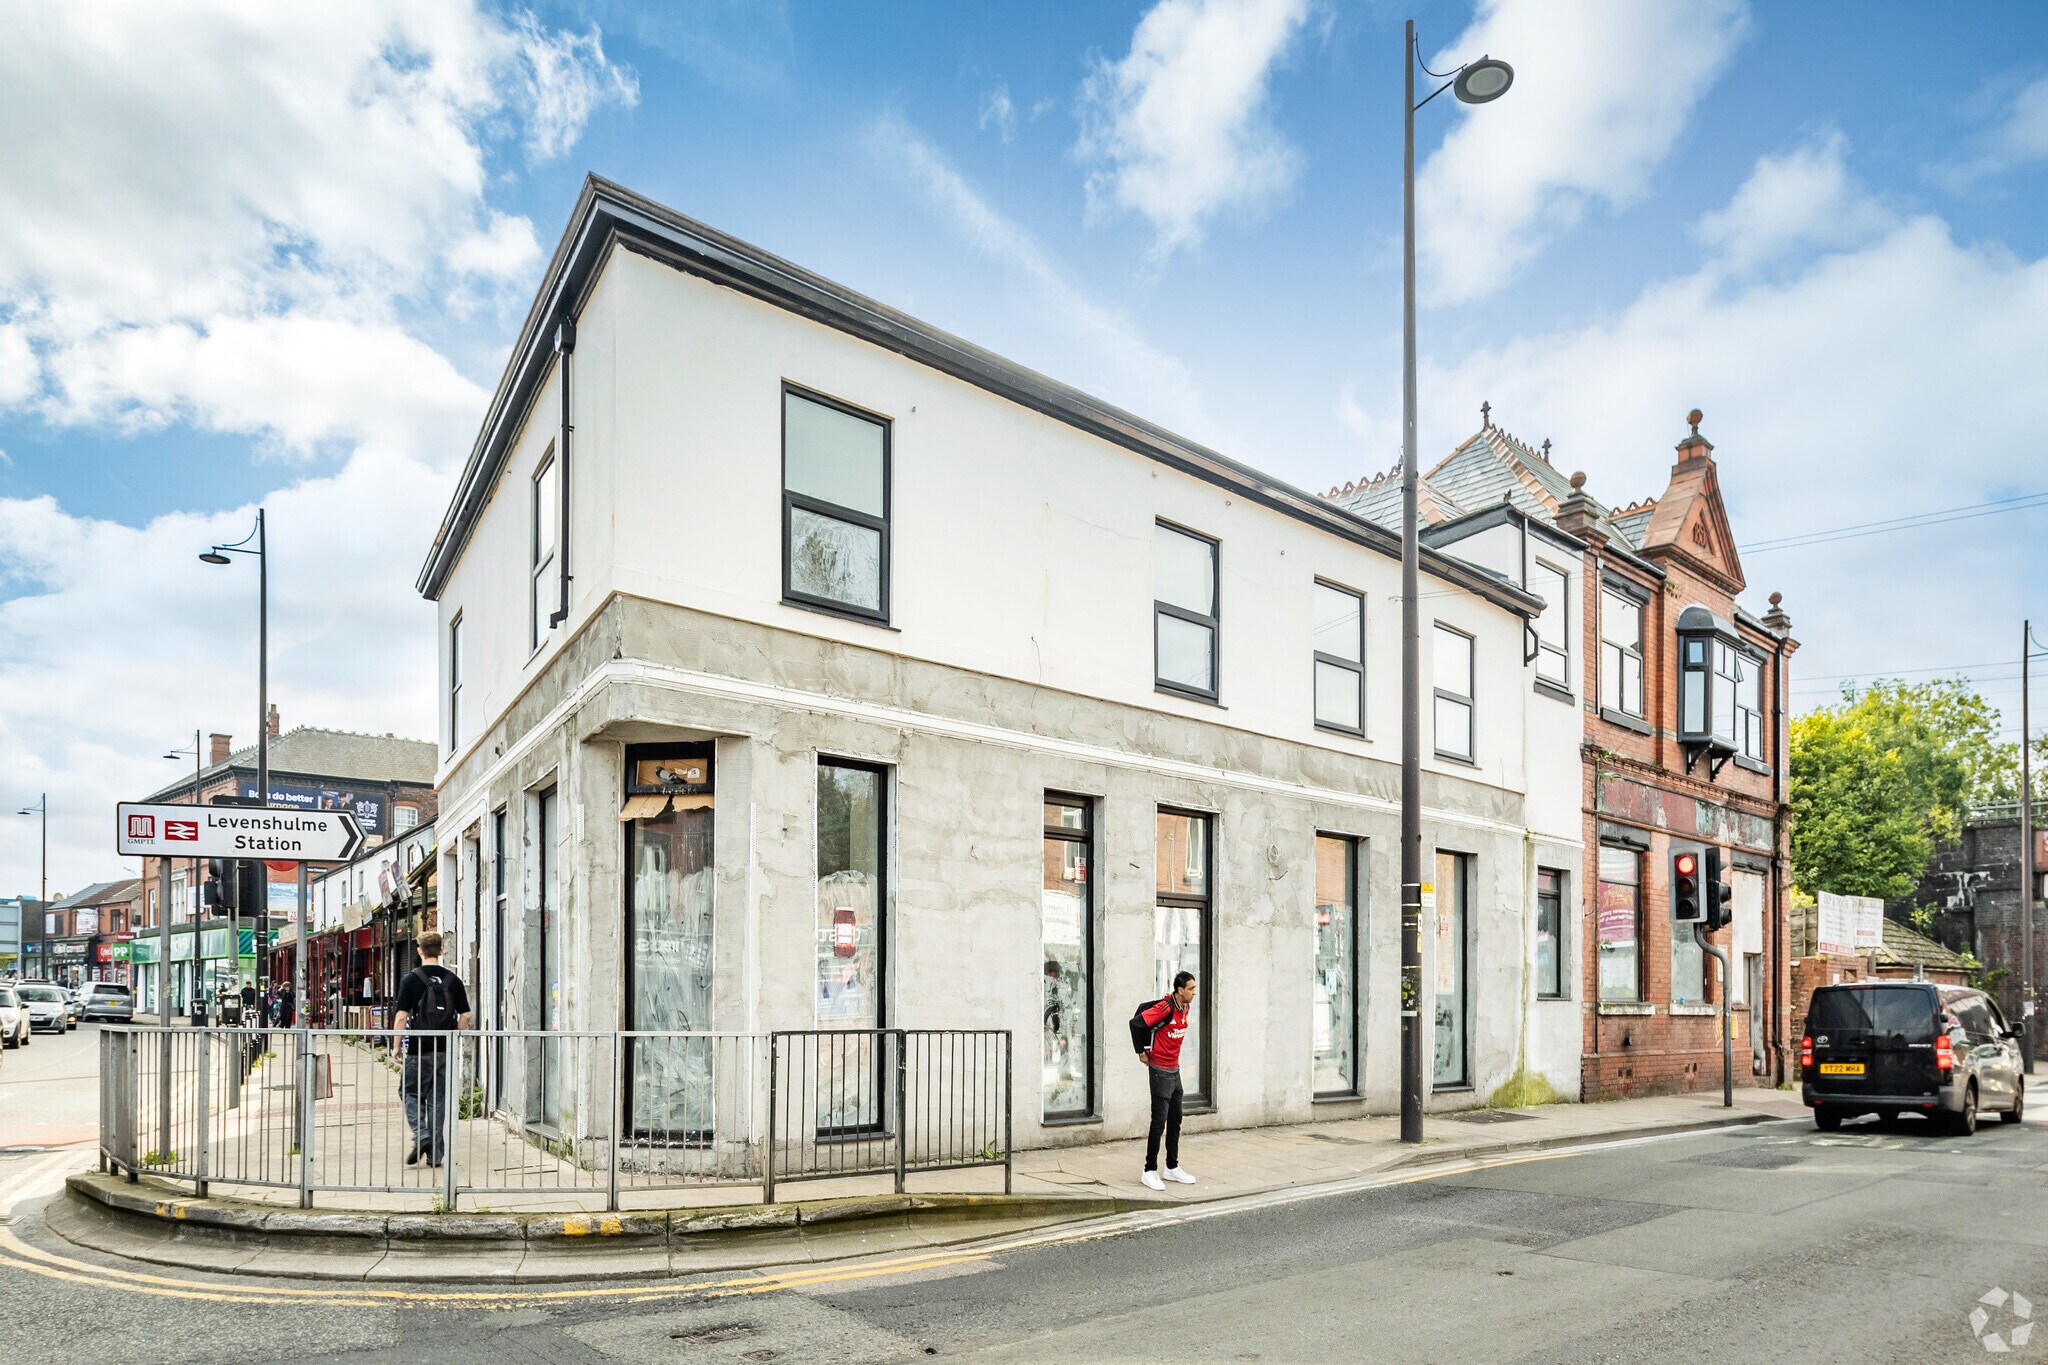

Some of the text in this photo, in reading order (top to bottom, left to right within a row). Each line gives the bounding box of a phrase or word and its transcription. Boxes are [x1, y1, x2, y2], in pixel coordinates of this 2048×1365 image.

[248, 790, 271, 800] Bos
[286, 793, 314, 803] better
[208, 813, 328, 831] Levenshulme
[235, 835, 302, 851] Station
